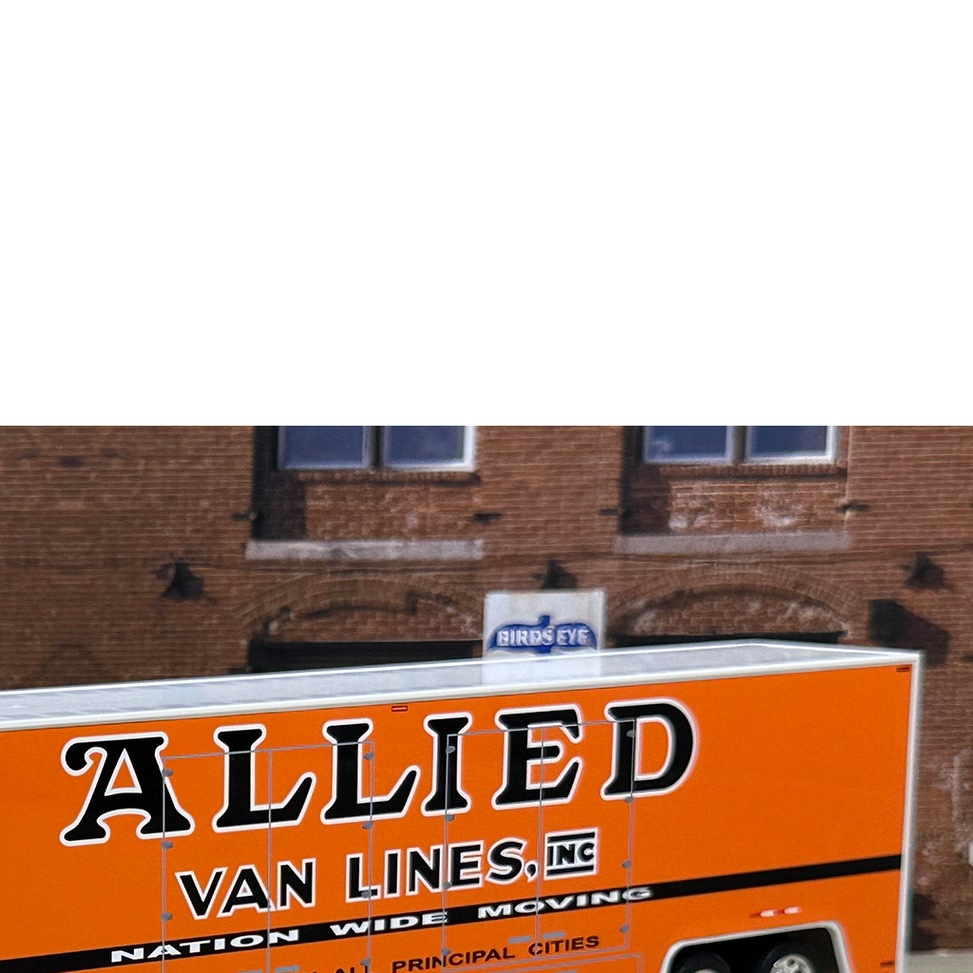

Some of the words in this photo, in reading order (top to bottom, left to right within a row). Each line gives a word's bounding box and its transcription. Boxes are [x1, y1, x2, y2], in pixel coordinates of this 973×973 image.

[556, 628, 591, 647] EYE
[60, 698, 696, 846] ALLIED
[174, 858, 317, 920] VAN
[545, 838, 597, 869] INC
[111, 929, 300, 963] NATION
[329, 911, 449, 937] WIDE
[477, 888, 654, 919] MOVING
[391, 947, 516, 973] PRINCIPAL
[528, 935, 600, 956] CITIES
